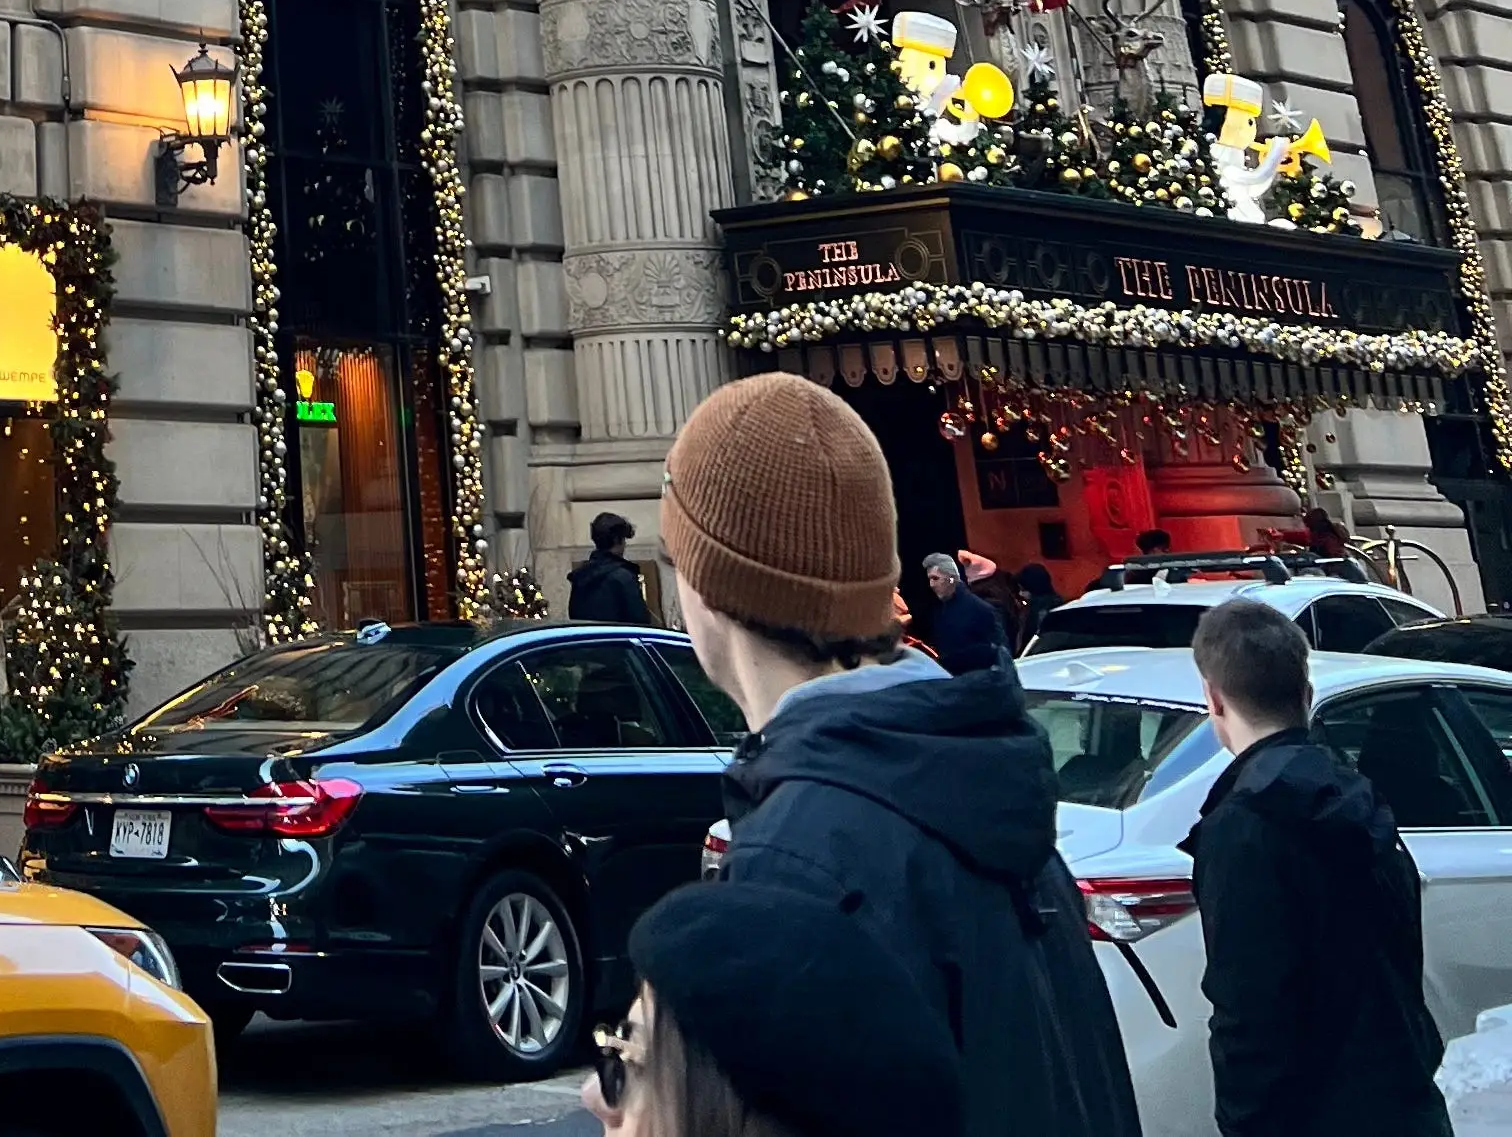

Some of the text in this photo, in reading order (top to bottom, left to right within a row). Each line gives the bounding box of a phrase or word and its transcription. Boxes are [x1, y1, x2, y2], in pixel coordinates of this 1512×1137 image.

[818, 240, 859, 263] THE
[783, 262, 902, 292] PENINSULA
[1113, 256, 1340, 319] THE PENINSULA
